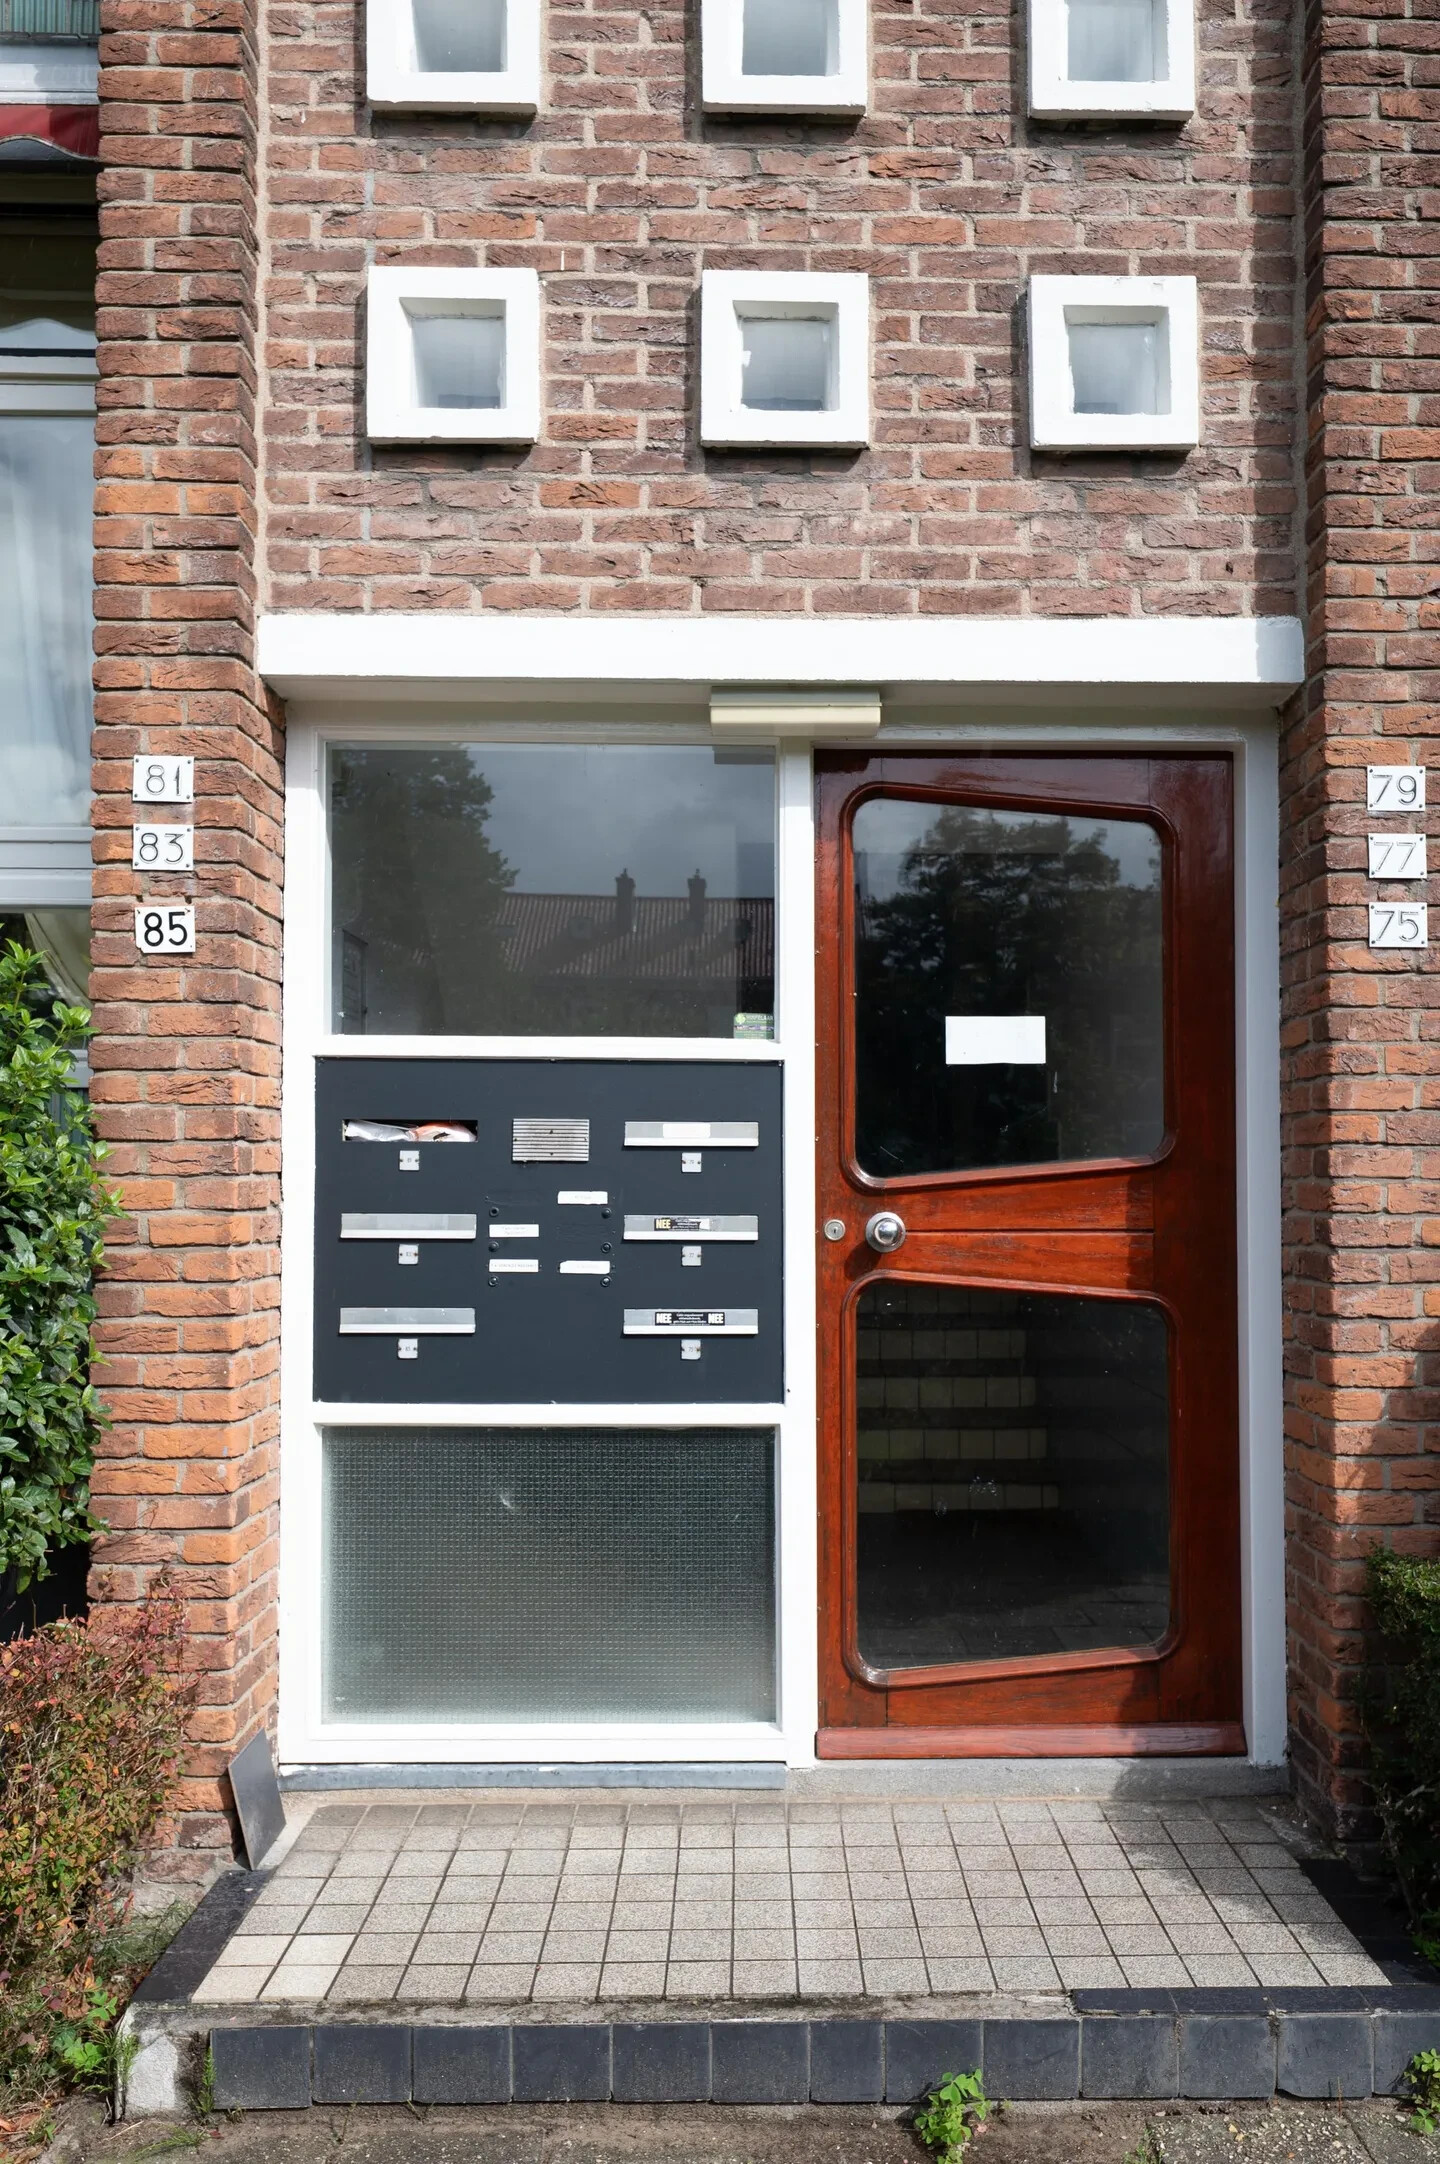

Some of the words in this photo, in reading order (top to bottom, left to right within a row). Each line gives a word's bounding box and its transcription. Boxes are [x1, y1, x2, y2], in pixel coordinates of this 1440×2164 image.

[146, 764, 181, 796] 81
[1372, 774, 1417, 806] 79
[139, 832, 185, 864] 83
[1373, 841, 1417, 872] 77
[144, 911, 188, 947] 85
[1375, 910, 1419, 942] 75
[656, 1219, 671, 1229] NEE
[656, 1313, 672, 1323] NEE
[708, 1313, 724, 1323] NEE
